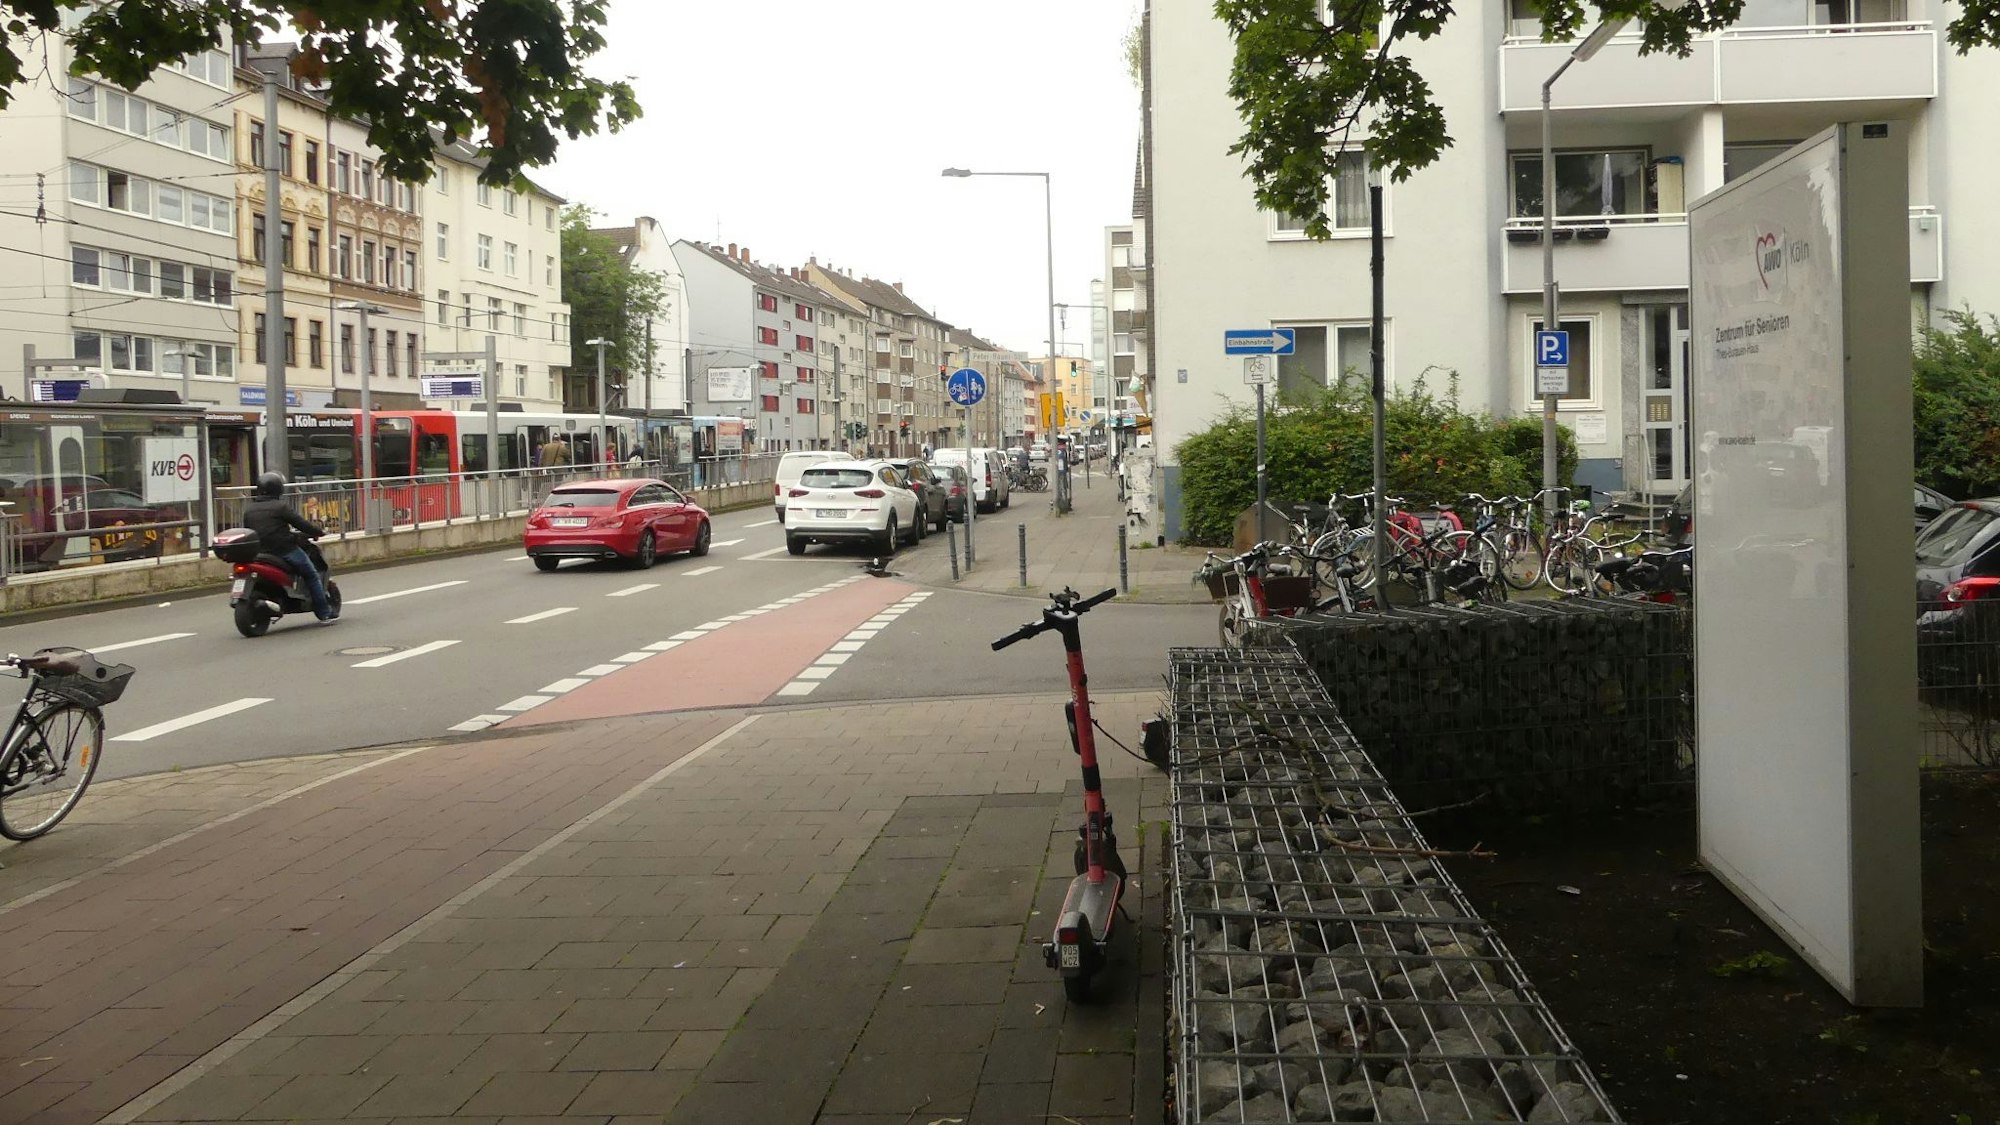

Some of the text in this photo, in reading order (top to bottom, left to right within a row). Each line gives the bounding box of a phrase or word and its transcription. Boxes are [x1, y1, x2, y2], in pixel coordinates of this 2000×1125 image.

[1763, 240, 1809, 273] AWO Köln
[1715, 314, 1790, 343] Zentrum für Senioren
[1228, 338, 1274, 346] Einbahnstraße
[1542, 335, 1559, 361] P
[295, 414, 318, 428] Köln
[318, 419, 331, 427] und
[331, 417, 354, 427] Umland
[151, 460, 176, 476] KVB
